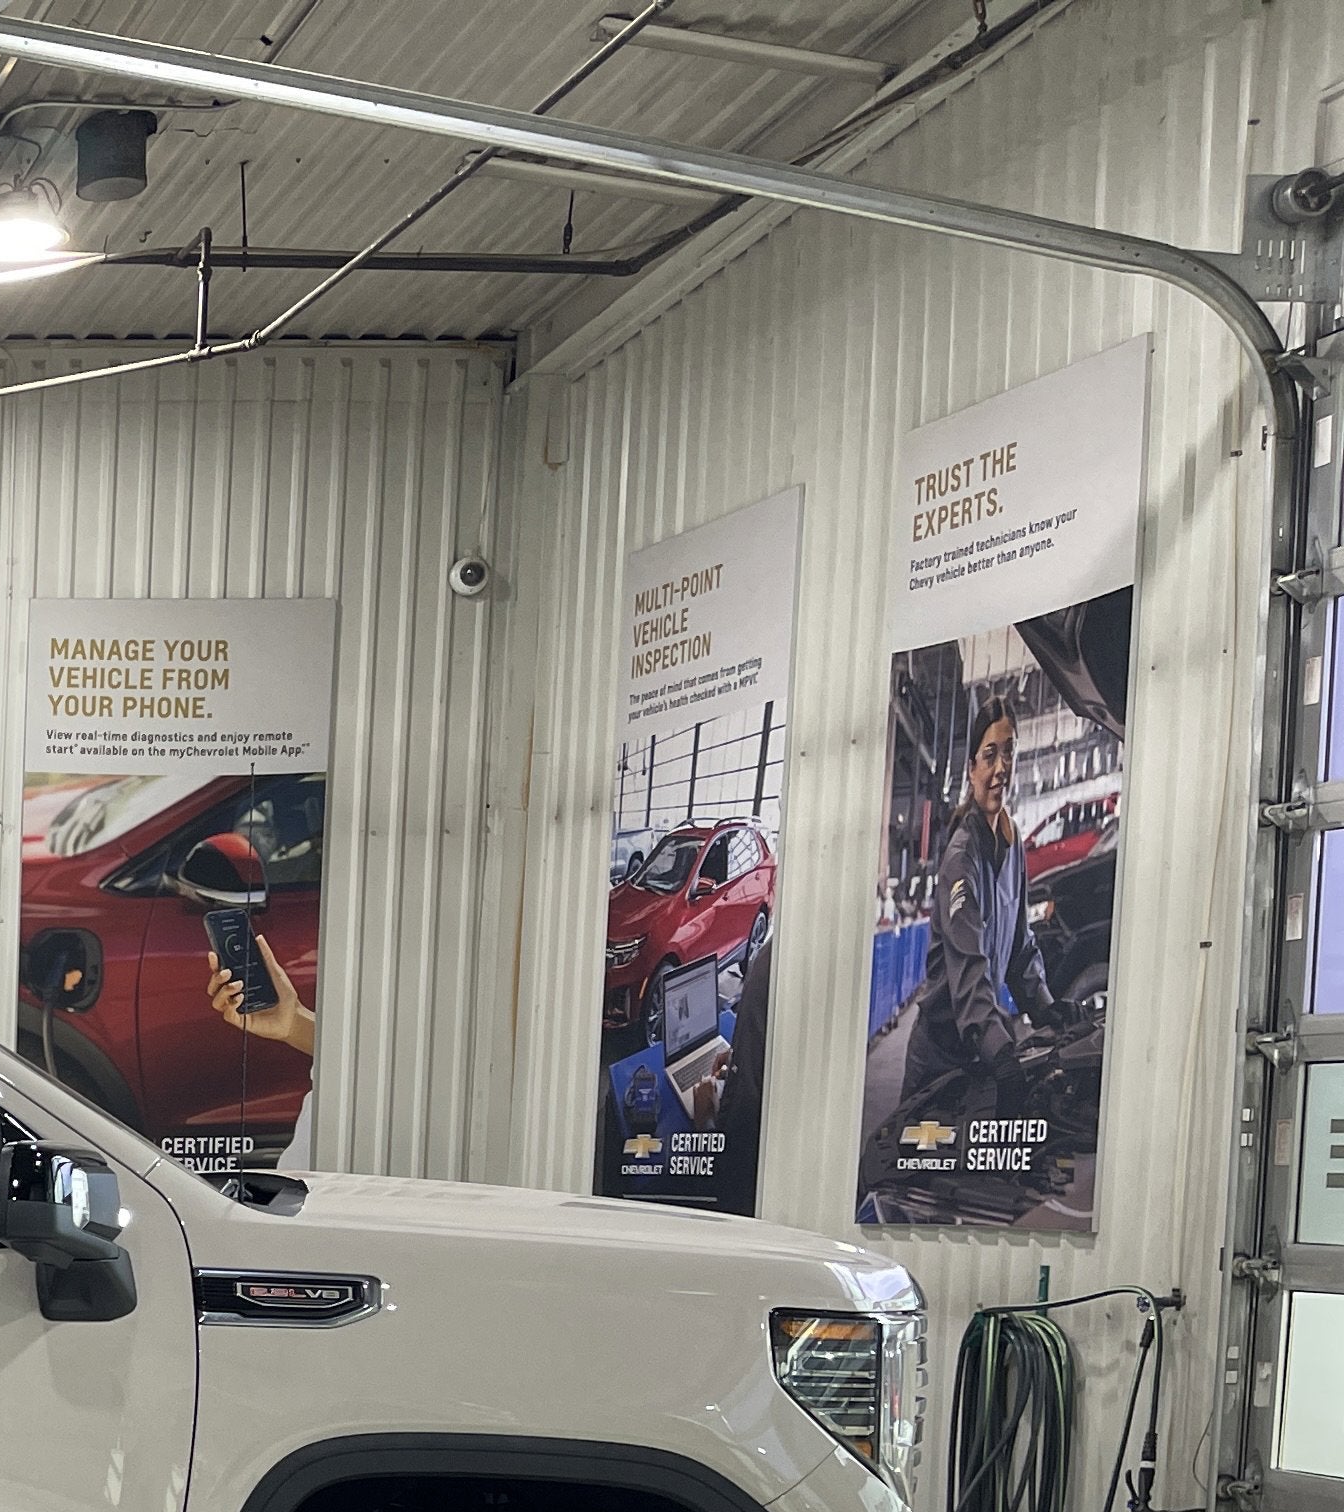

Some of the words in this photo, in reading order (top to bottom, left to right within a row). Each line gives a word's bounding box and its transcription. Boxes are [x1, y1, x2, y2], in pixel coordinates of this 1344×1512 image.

[914, 457, 974, 505] TRUST
[980, 441, 1017, 482] THE
[912, 487, 1004, 542] EXPERTS.
[910, 552, 942, 573] Factory
[944, 540, 974, 563] trained
[976, 527, 1027, 553] technicians
[1029, 518, 1053, 534] know
[1055, 508, 1078, 529] your
[909, 576, 934, 591] Chevy
[936, 564, 965, 583] vehicle
[967, 557, 994, 575] better
[997, 550, 1017, 566] than
[1019, 537, 1055, 558] anyone.
[634, 563, 723, 617] MULTI-POINT
[633, 607, 688, 648] VEHICLE
[50, 638, 155, 662] MANAGE
[164, 639, 229, 662] YOUR
[630, 631, 712, 680] INSPECTION
[49, 666, 153, 689] VEHICLE
[162, 668, 230, 690] FROM
[667, 679, 683, 694] mind
[48, 694, 113, 717] YOUR
[122, 696, 213, 719] PHONE.
[46, 729, 72, 741] View
[75, 730, 128, 742] real-time
[131, 730, 194, 745] diagnostics
[197, 731, 217, 742] and
[221, 731, 250, 745] enjoy
[253, 730, 293, 742] remote
[79, 745, 128, 757] available
[131, 747, 145, 757] on
[148, 746, 166, 757] the
[169, 746, 240, 759] myChevrolet
[242, 745, 277, 756] Mobile
[671, 1133, 725, 1153] CERTIFIED
[969, 1119, 1048, 1143] CERTIFIED
[161, 1136, 254, 1154] CERTIFIED
[669, 1156, 714, 1175] SERVICE
[897, 1158, 957, 1171] CHEVROLET
[966, 1148, 1032, 1171] SERVICE
